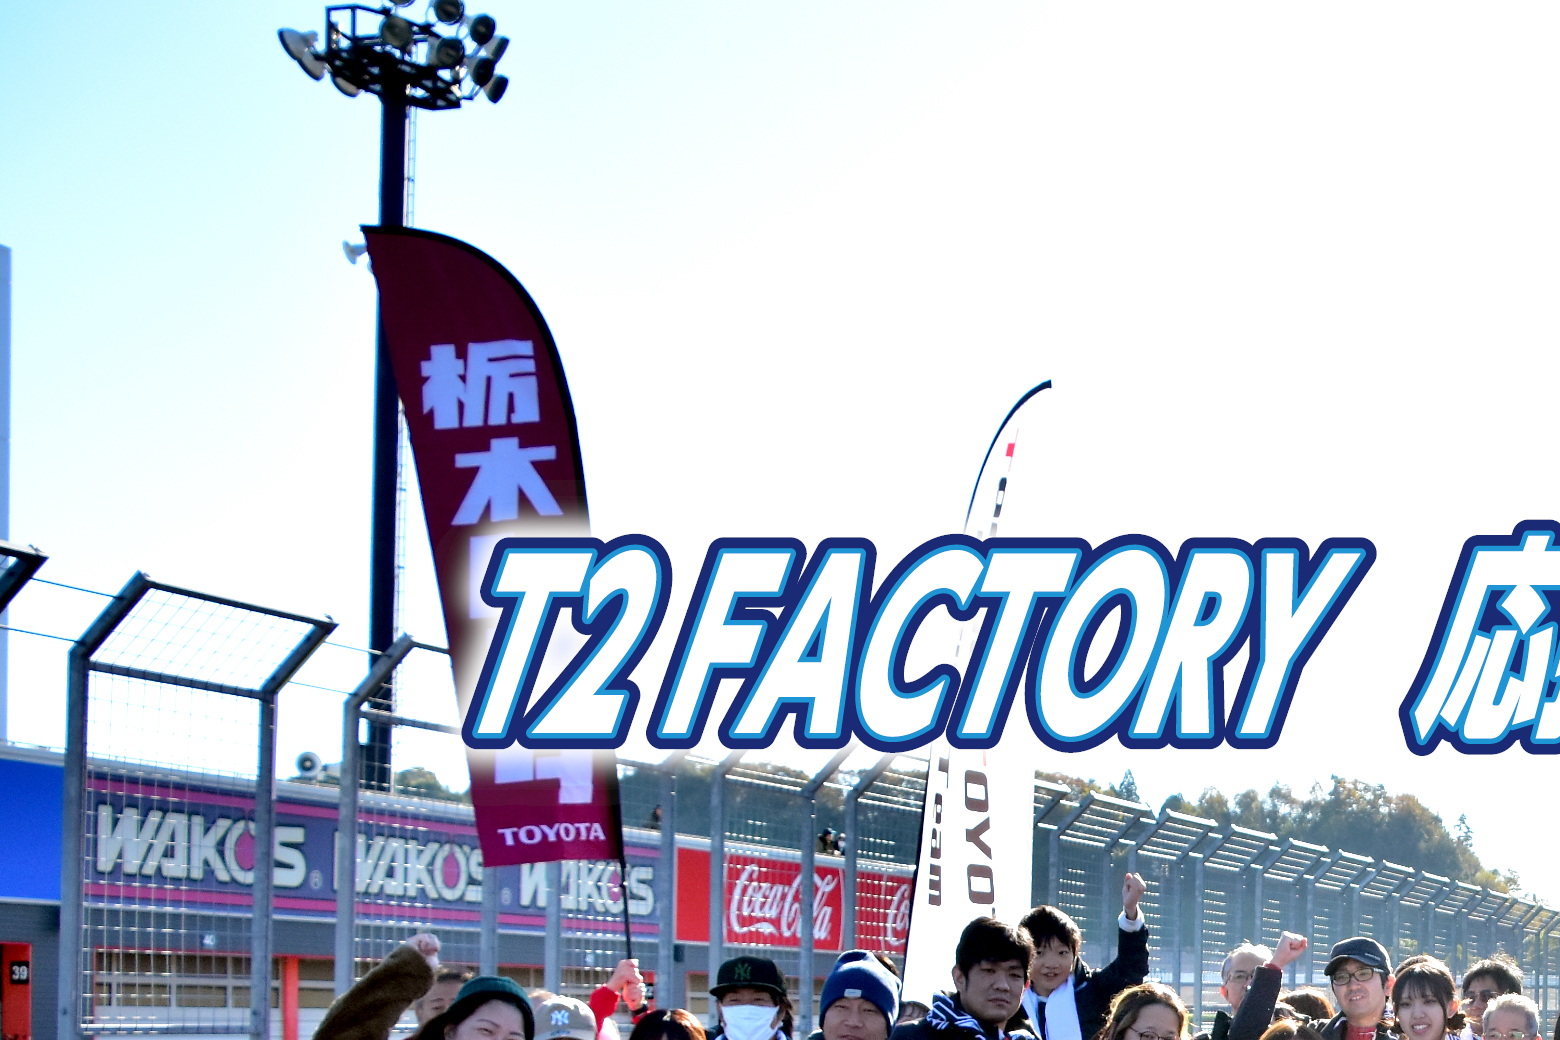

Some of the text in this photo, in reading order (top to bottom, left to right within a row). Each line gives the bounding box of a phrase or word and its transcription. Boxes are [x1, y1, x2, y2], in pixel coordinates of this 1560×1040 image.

[97, 804, 307, 888] WAKOS
[497, 822, 607, 847] TOYOTA
[11, 965, 28, 981] 39
